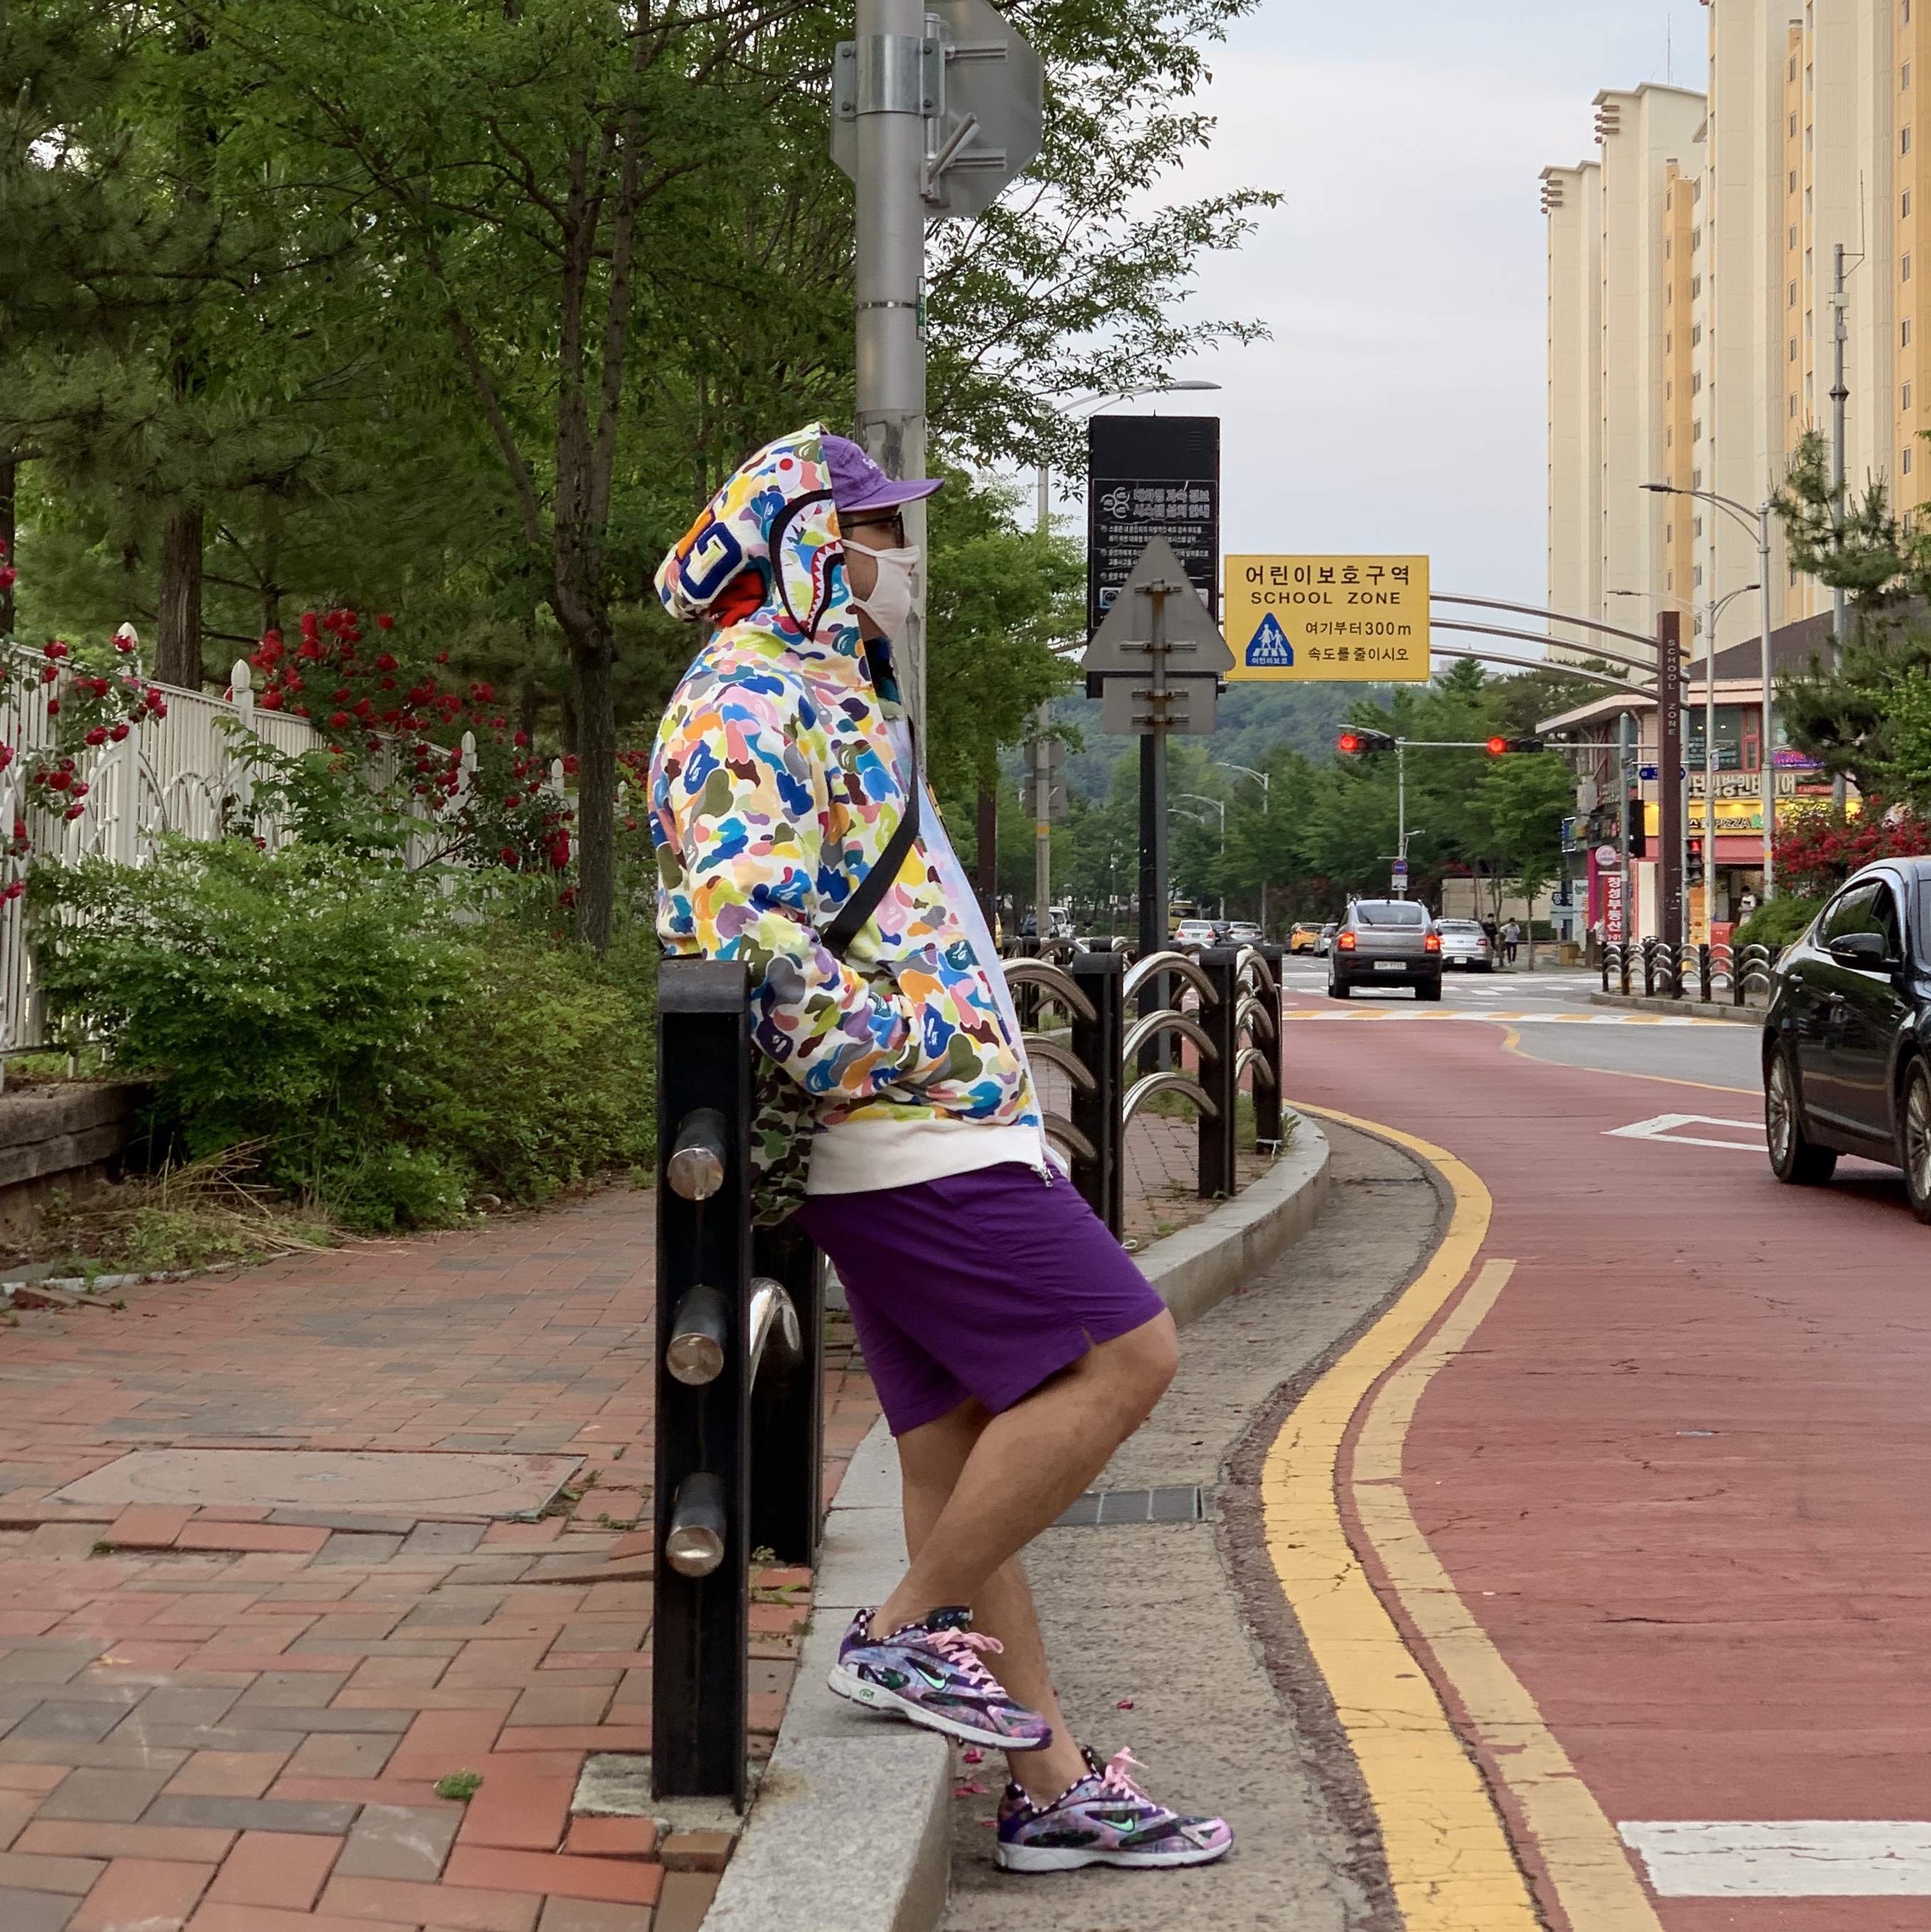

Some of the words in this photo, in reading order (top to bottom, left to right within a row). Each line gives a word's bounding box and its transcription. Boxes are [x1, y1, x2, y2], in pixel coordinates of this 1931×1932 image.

[1133, 504, 1165, 517] 시스템
[1189, 504, 1210, 517] 안내
[1246, 565, 1409, 586] 어린이보호구역
[1251, 592, 1333, 605] SCHOOL
[1347, 592, 1401, 605] ZONE
[1308, 647, 1350, 661] 속도를
[1353, 647, 1409, 661] 줄이시오
[1667, 639, 1677, 690] SCHOOL
[1667, 703, 1677, 736] ZONE
[1714, 816, 1750, 829] PIZZA
